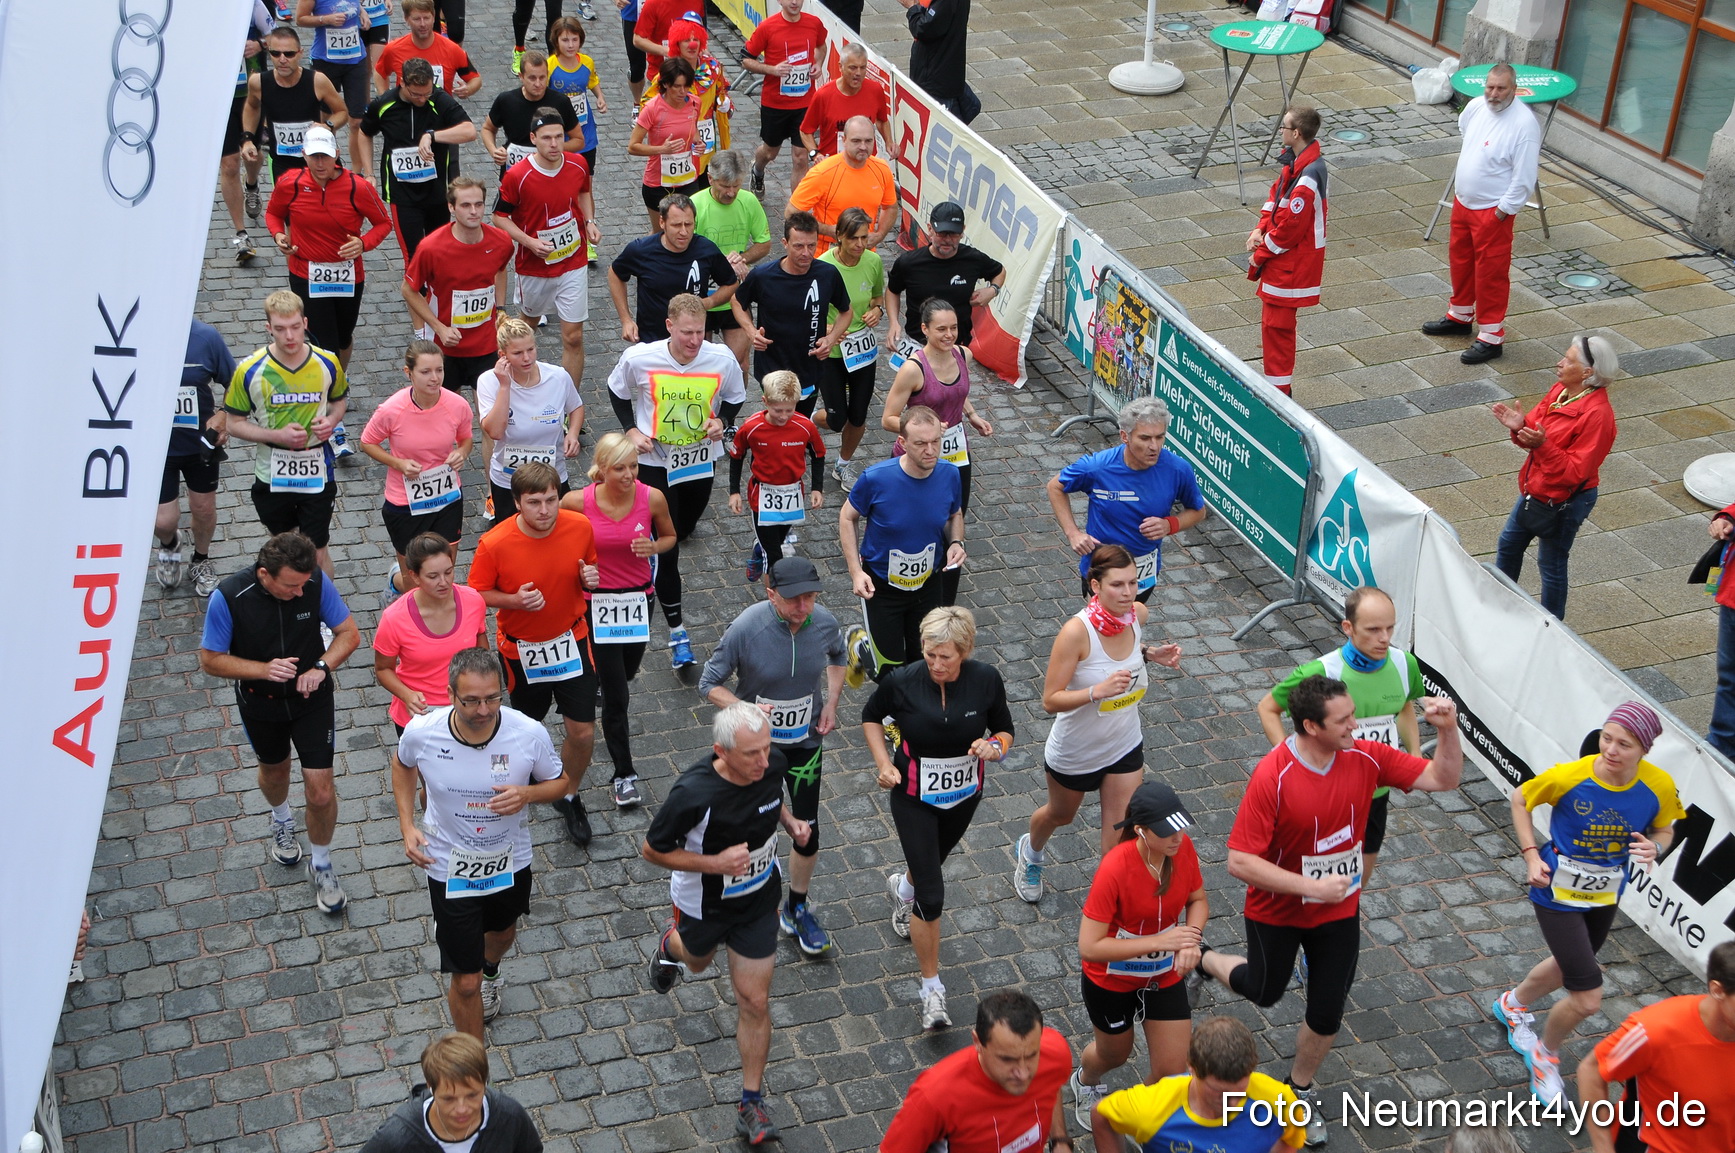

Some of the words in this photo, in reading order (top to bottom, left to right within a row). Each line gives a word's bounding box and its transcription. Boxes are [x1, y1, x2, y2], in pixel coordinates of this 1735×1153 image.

[331, 35, 357, 48] 2124
[279, 131, 305, 144] 244
[669, 159, 691, 175] 618
[549, 230, 573, 249] 145
[557, 247, 573, 257] David
[314, 268, 350, 283] 2812
[463, 297, 488, 313] 109
[845, 333, 875, 355] 2100
[661, 386, 702, 401] heute
[1182, 352, 1250, 419] Event-Leit-Systeme
[82, 293, 140, 498] BKK
[272, 391, 322, 405] BOCK
[663, 403, 703, 432] 40
[1160, 373, 1190, 413] Mehr
[1192, 402, 1250, 469] Sicherheit
[1176, 416, 1192, 444] Ihr
[1195, 432, 1232, 481] Event!
[671, 448, 709, 469] 3370
[277, 460, 320, 476] 2855
[287, 479, 308, 487] Bernd
[411, 475, 453, 500] 2574
[424, 498, 448, 508] Regina
[763, 493, 800, 510] 3371
[1203, 480, 1221, 504] Line:
[1222, 497, 1244, 525] 09181
[1245, 520, 1264, 544] 6352
[899, 559, 928, 577] 298
[898, 576, 927, 587] Christian
[599, 605, 643, 624] 2114
[609, 628, 634, 636] Andrea
[52, 543, 124, 768] Audi
[526, 640, 571, 667] 2117
[540, 666, 568, 676] Markus
[1113, 696, 1136, 709] Sabrina
[772, 708, 808, 727] 307
[772, 730, 792, 738] Hans
[1459, 712, 1472, 732] die
[1473, 730, 1522, 783] verbinden
[928, 766, 973, 791] 2694
[934, 791, 967, 803] Angelika
[452, 850, 474, 860] PARTL
[475, 851, 506, 861] Neumarkt
[455, 856, 508, 879] 2260
[1571, 873, 1610, 891] 123
[1629, 861, 1706, 948] werke
[1125, 963, 1160, 972] Stefanie
